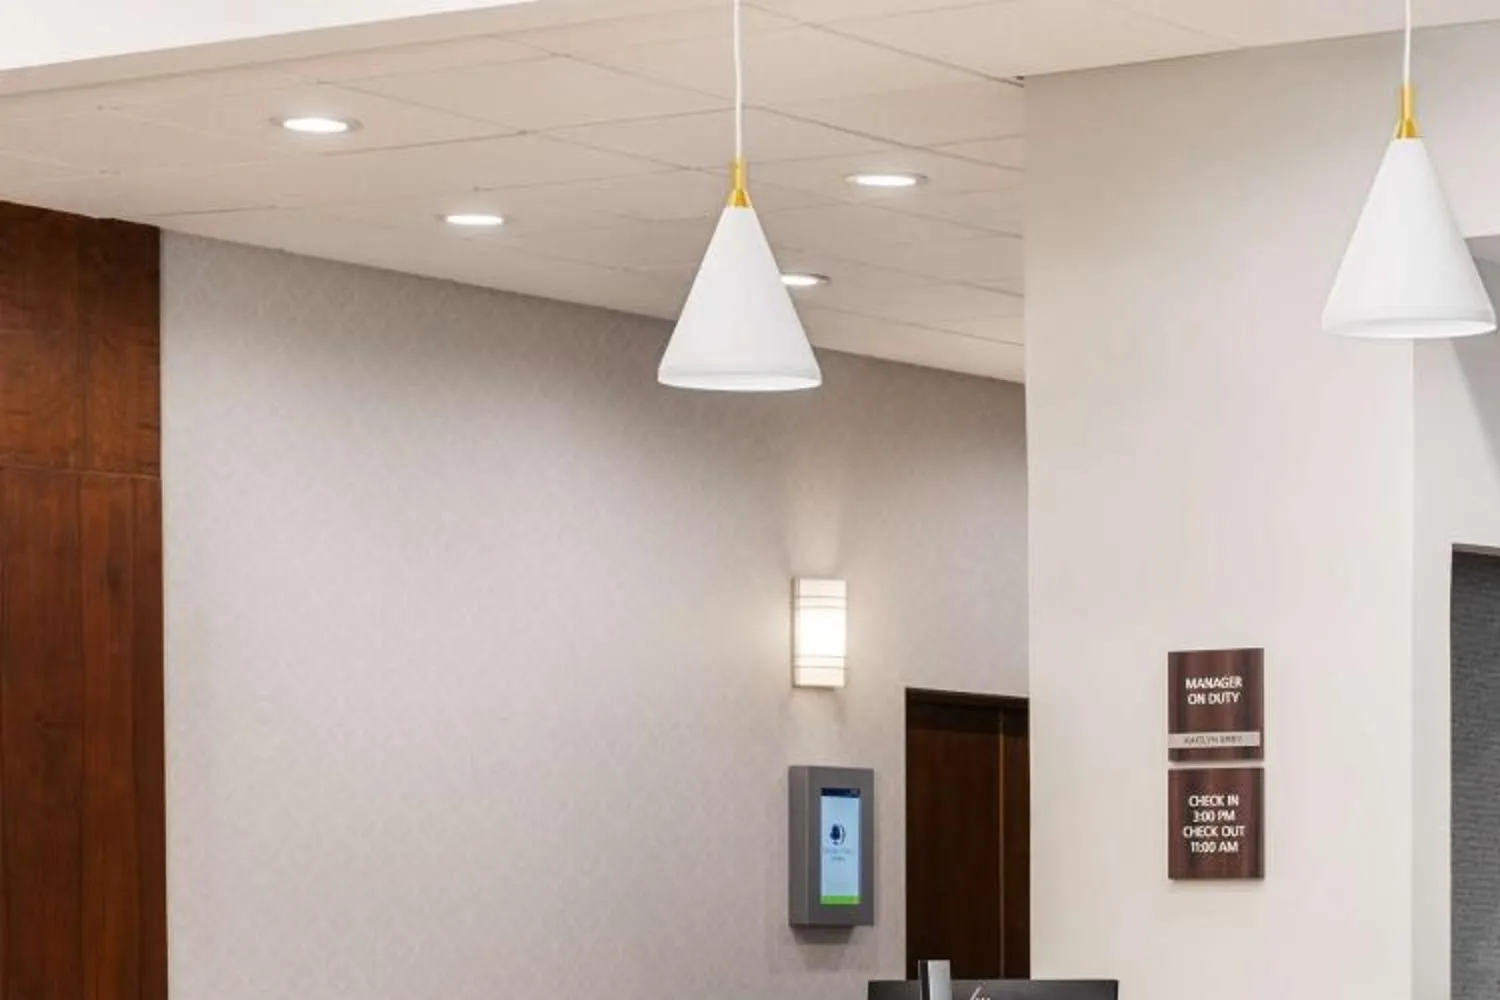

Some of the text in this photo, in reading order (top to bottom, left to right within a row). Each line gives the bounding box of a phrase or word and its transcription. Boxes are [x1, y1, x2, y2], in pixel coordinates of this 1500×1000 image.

[1185, 676, 1243, 689] MANAGER
[1187, 691, 1241, 705] ON DUTY
[1188, 794, 1239, 807] CHECK IN
[1193, 809, 1236, 822] 3:00 PM
[1183, 825, 1246, 838] CHECK OUT
[1191, 841, 1239, 853] 11:00 AM
